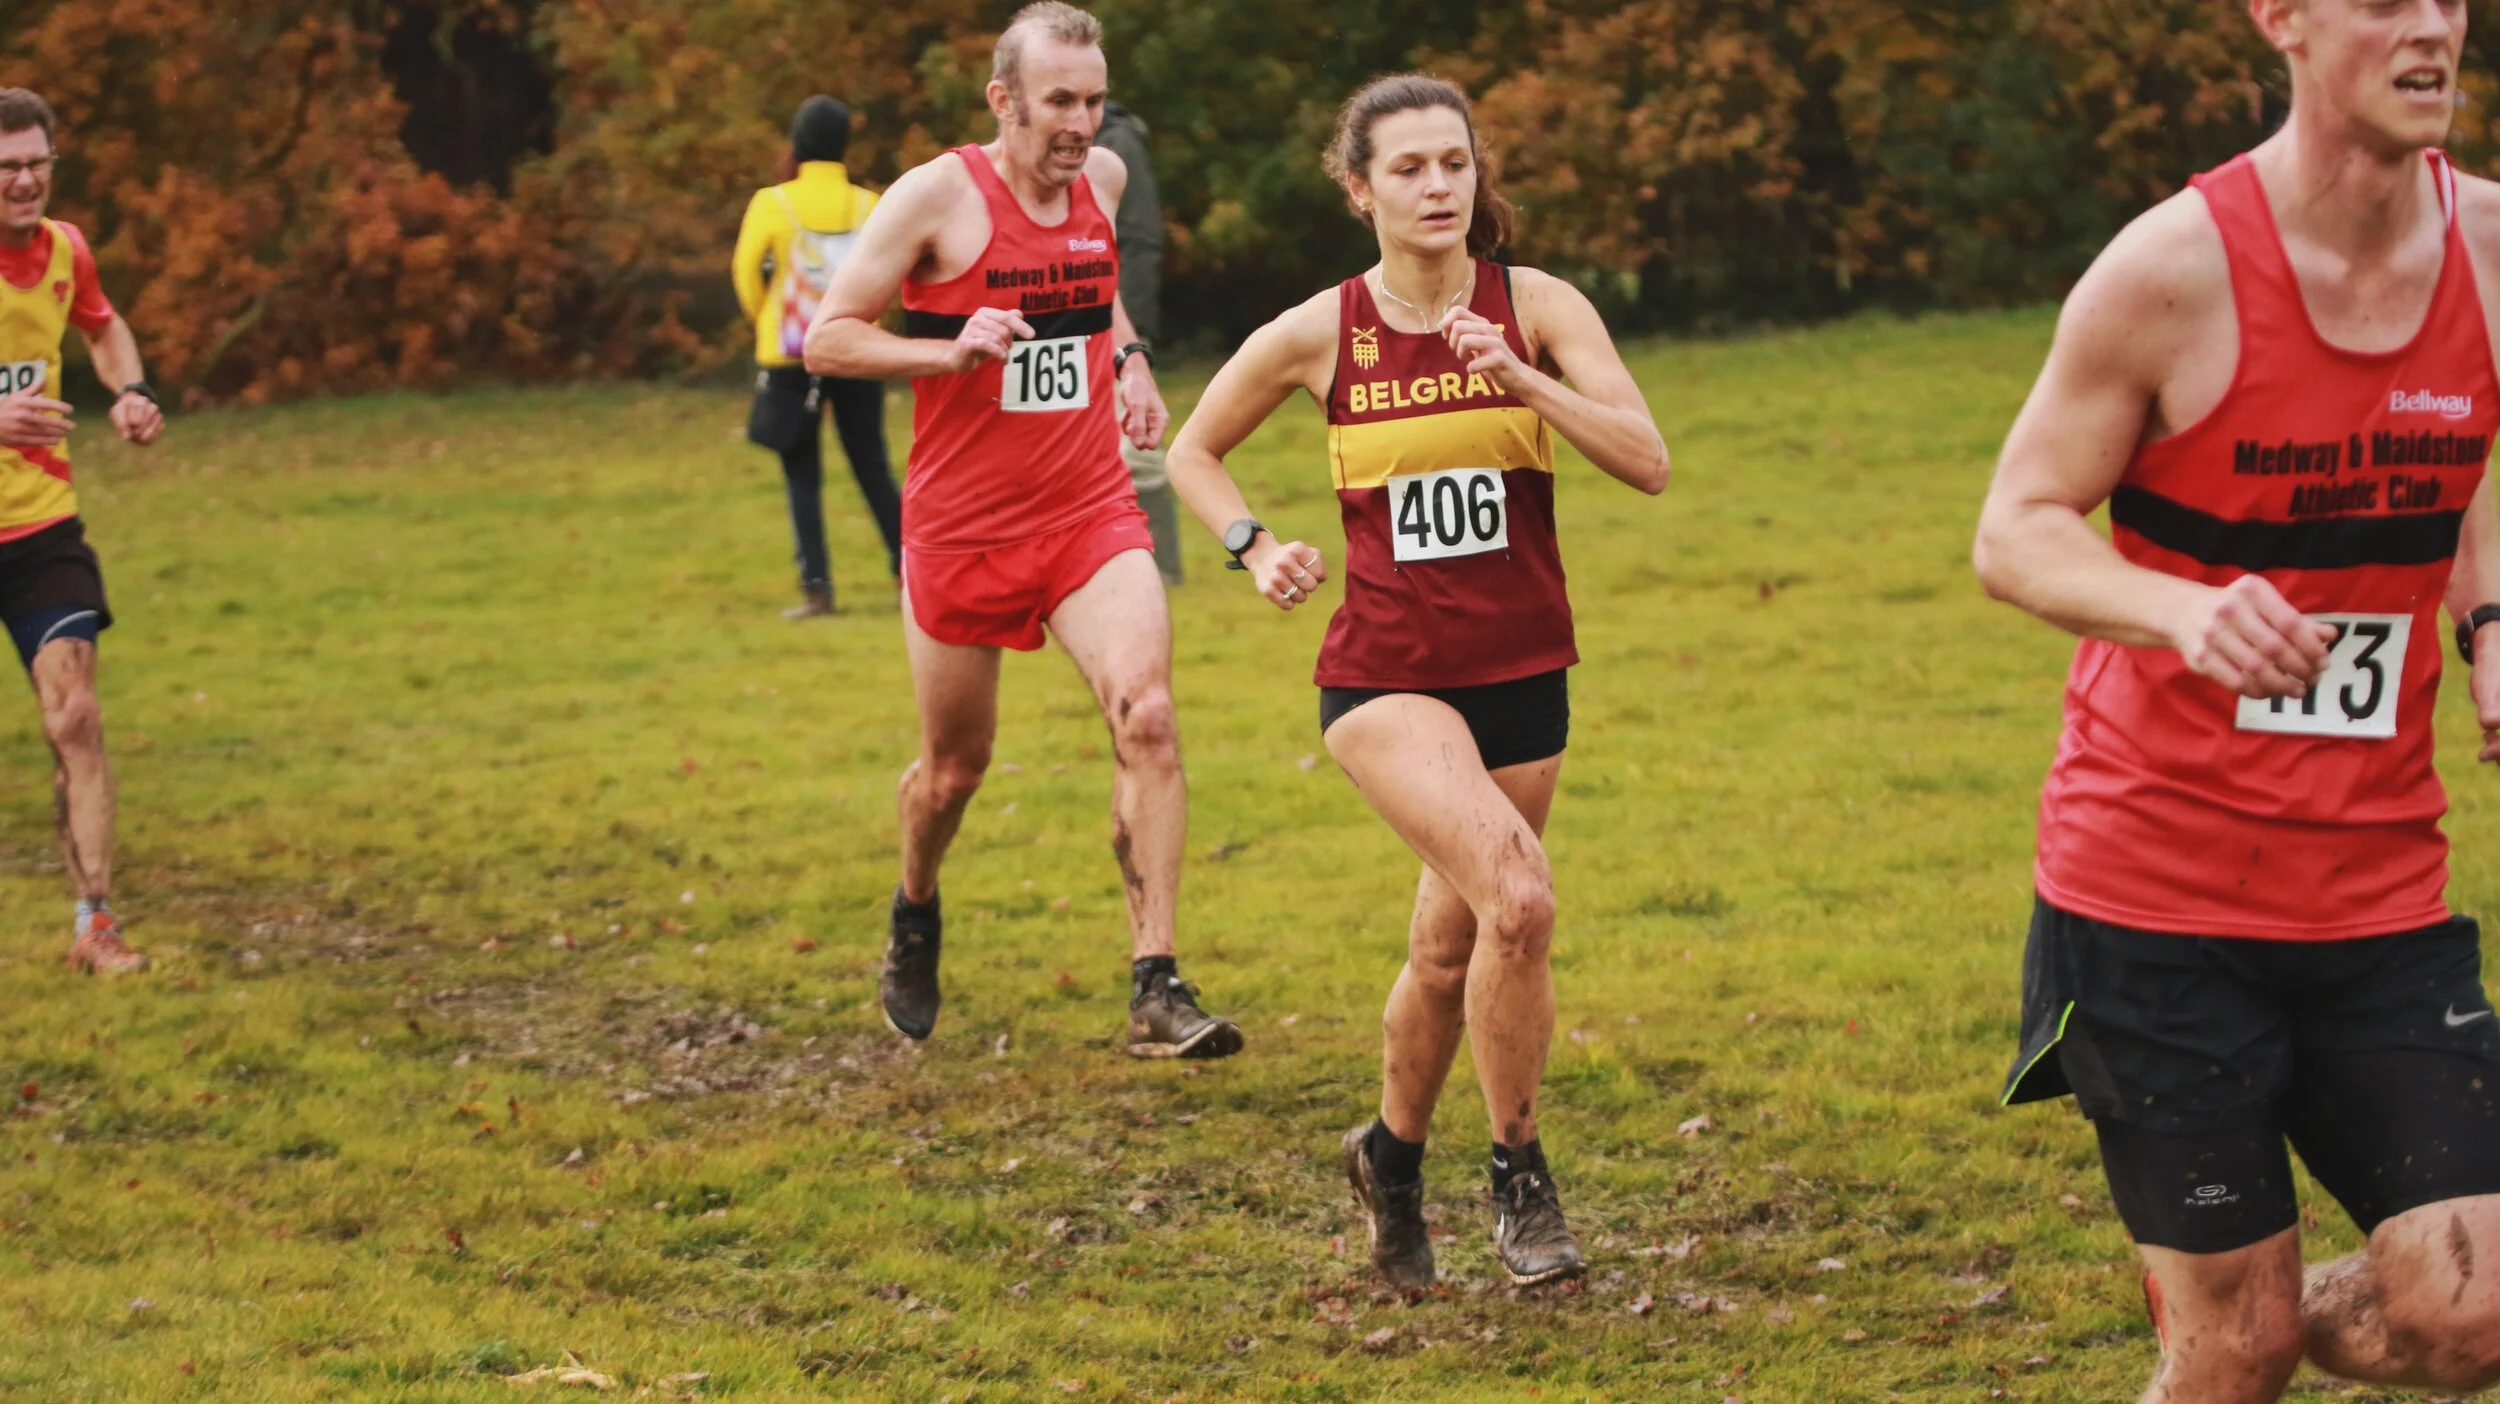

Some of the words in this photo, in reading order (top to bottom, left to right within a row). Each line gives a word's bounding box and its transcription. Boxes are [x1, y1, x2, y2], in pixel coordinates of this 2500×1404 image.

[986, 266, 1045, 289] Medway
[1020, 289, 1069, 310] Athletic
[1072, 285, 1099, 305] Club
[1012, 343, 1078, 402] 165
[2390, 389, 2472, 418] Bellway
[2234, 440, 2341, 476] Medway
[1397, 474, 1500, 548] 406
[2288, 480, 2378, 517] Athletic
[2388, 474, 2442, 509] Club
